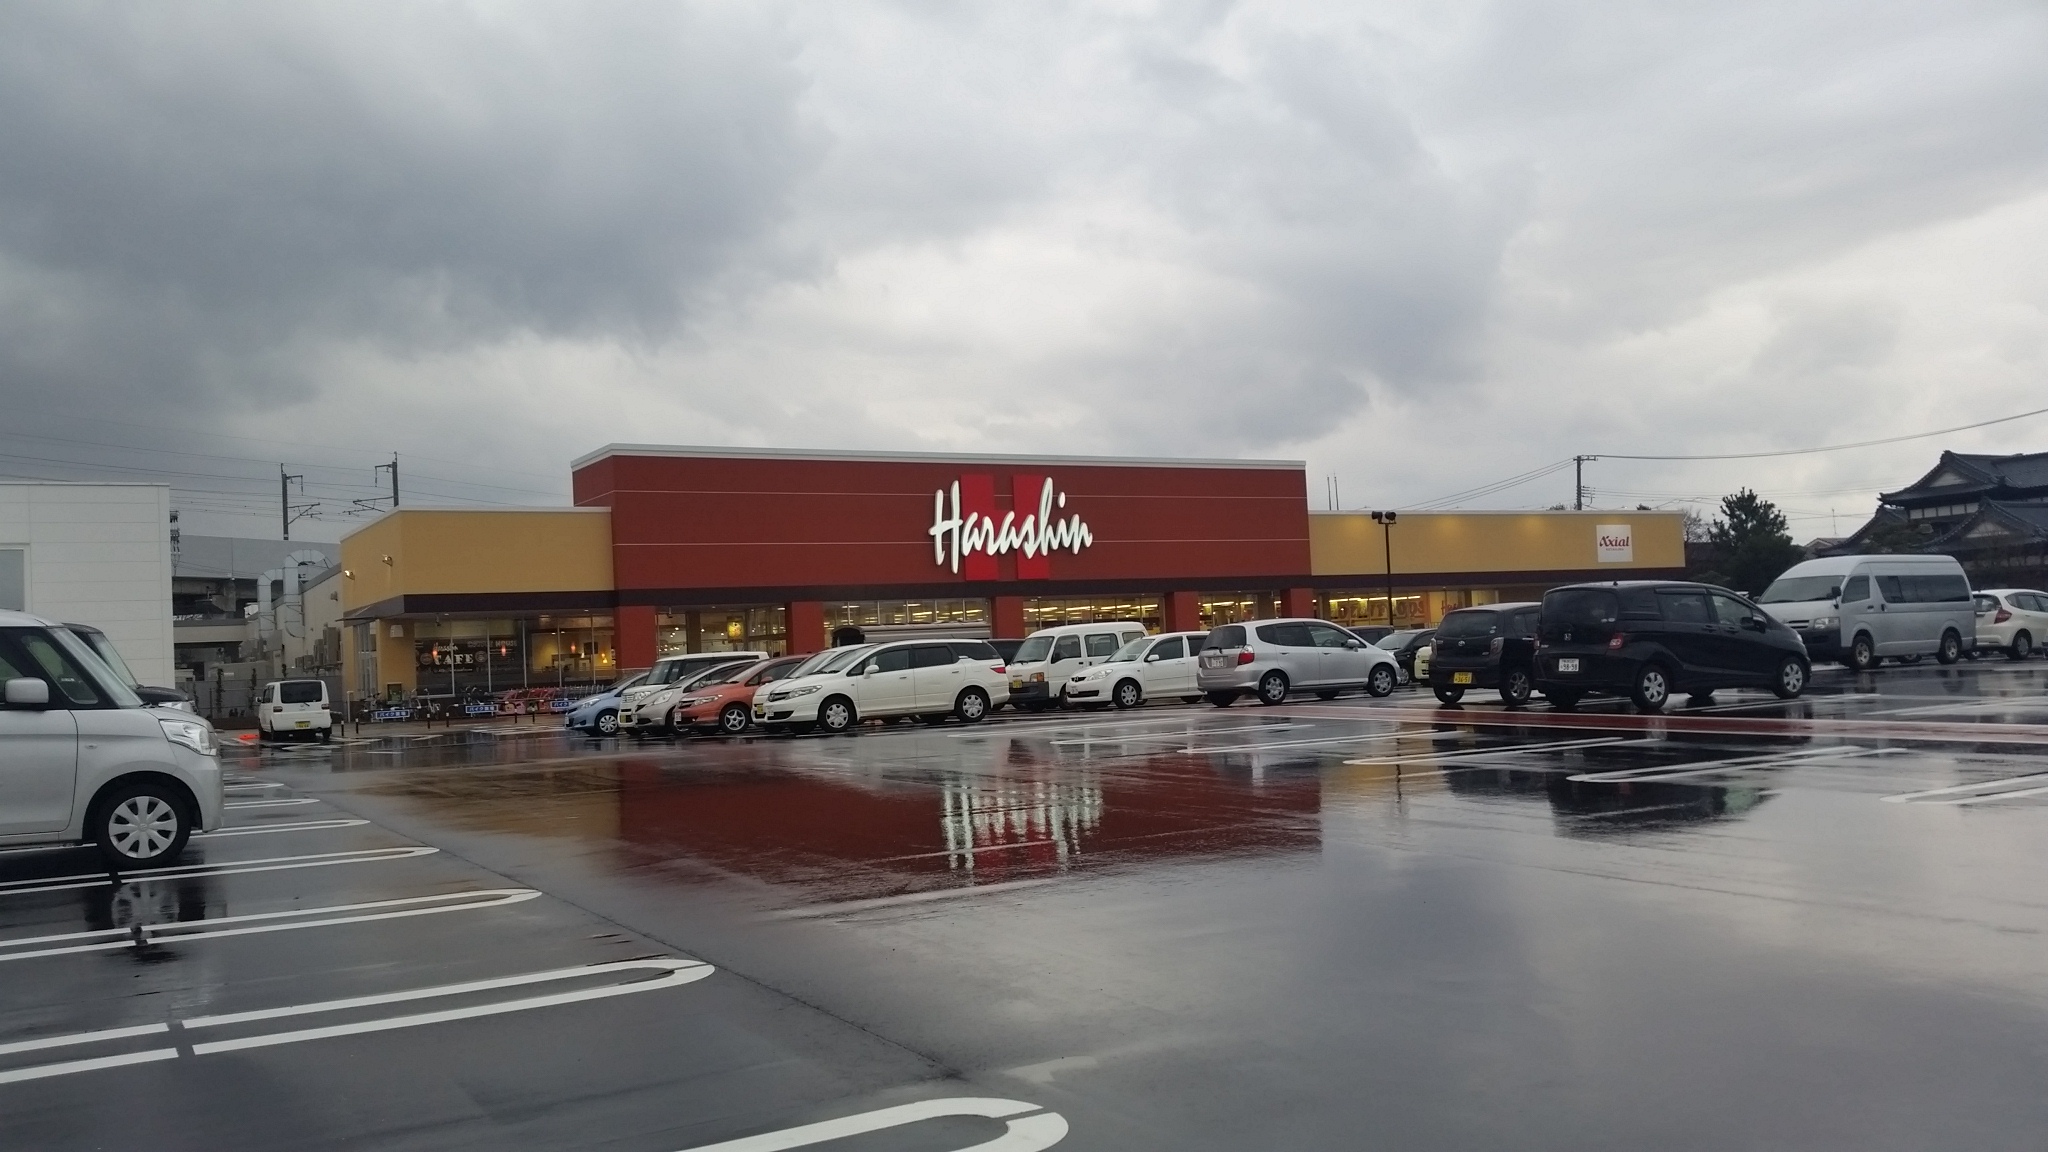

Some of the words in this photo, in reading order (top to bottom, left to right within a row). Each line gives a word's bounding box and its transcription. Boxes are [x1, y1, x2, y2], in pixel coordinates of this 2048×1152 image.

[928, 476, 1093, 575] Harashin
[1599, 535, 1630, 547] Axial
[434, 653, 474, 666] CAFE
